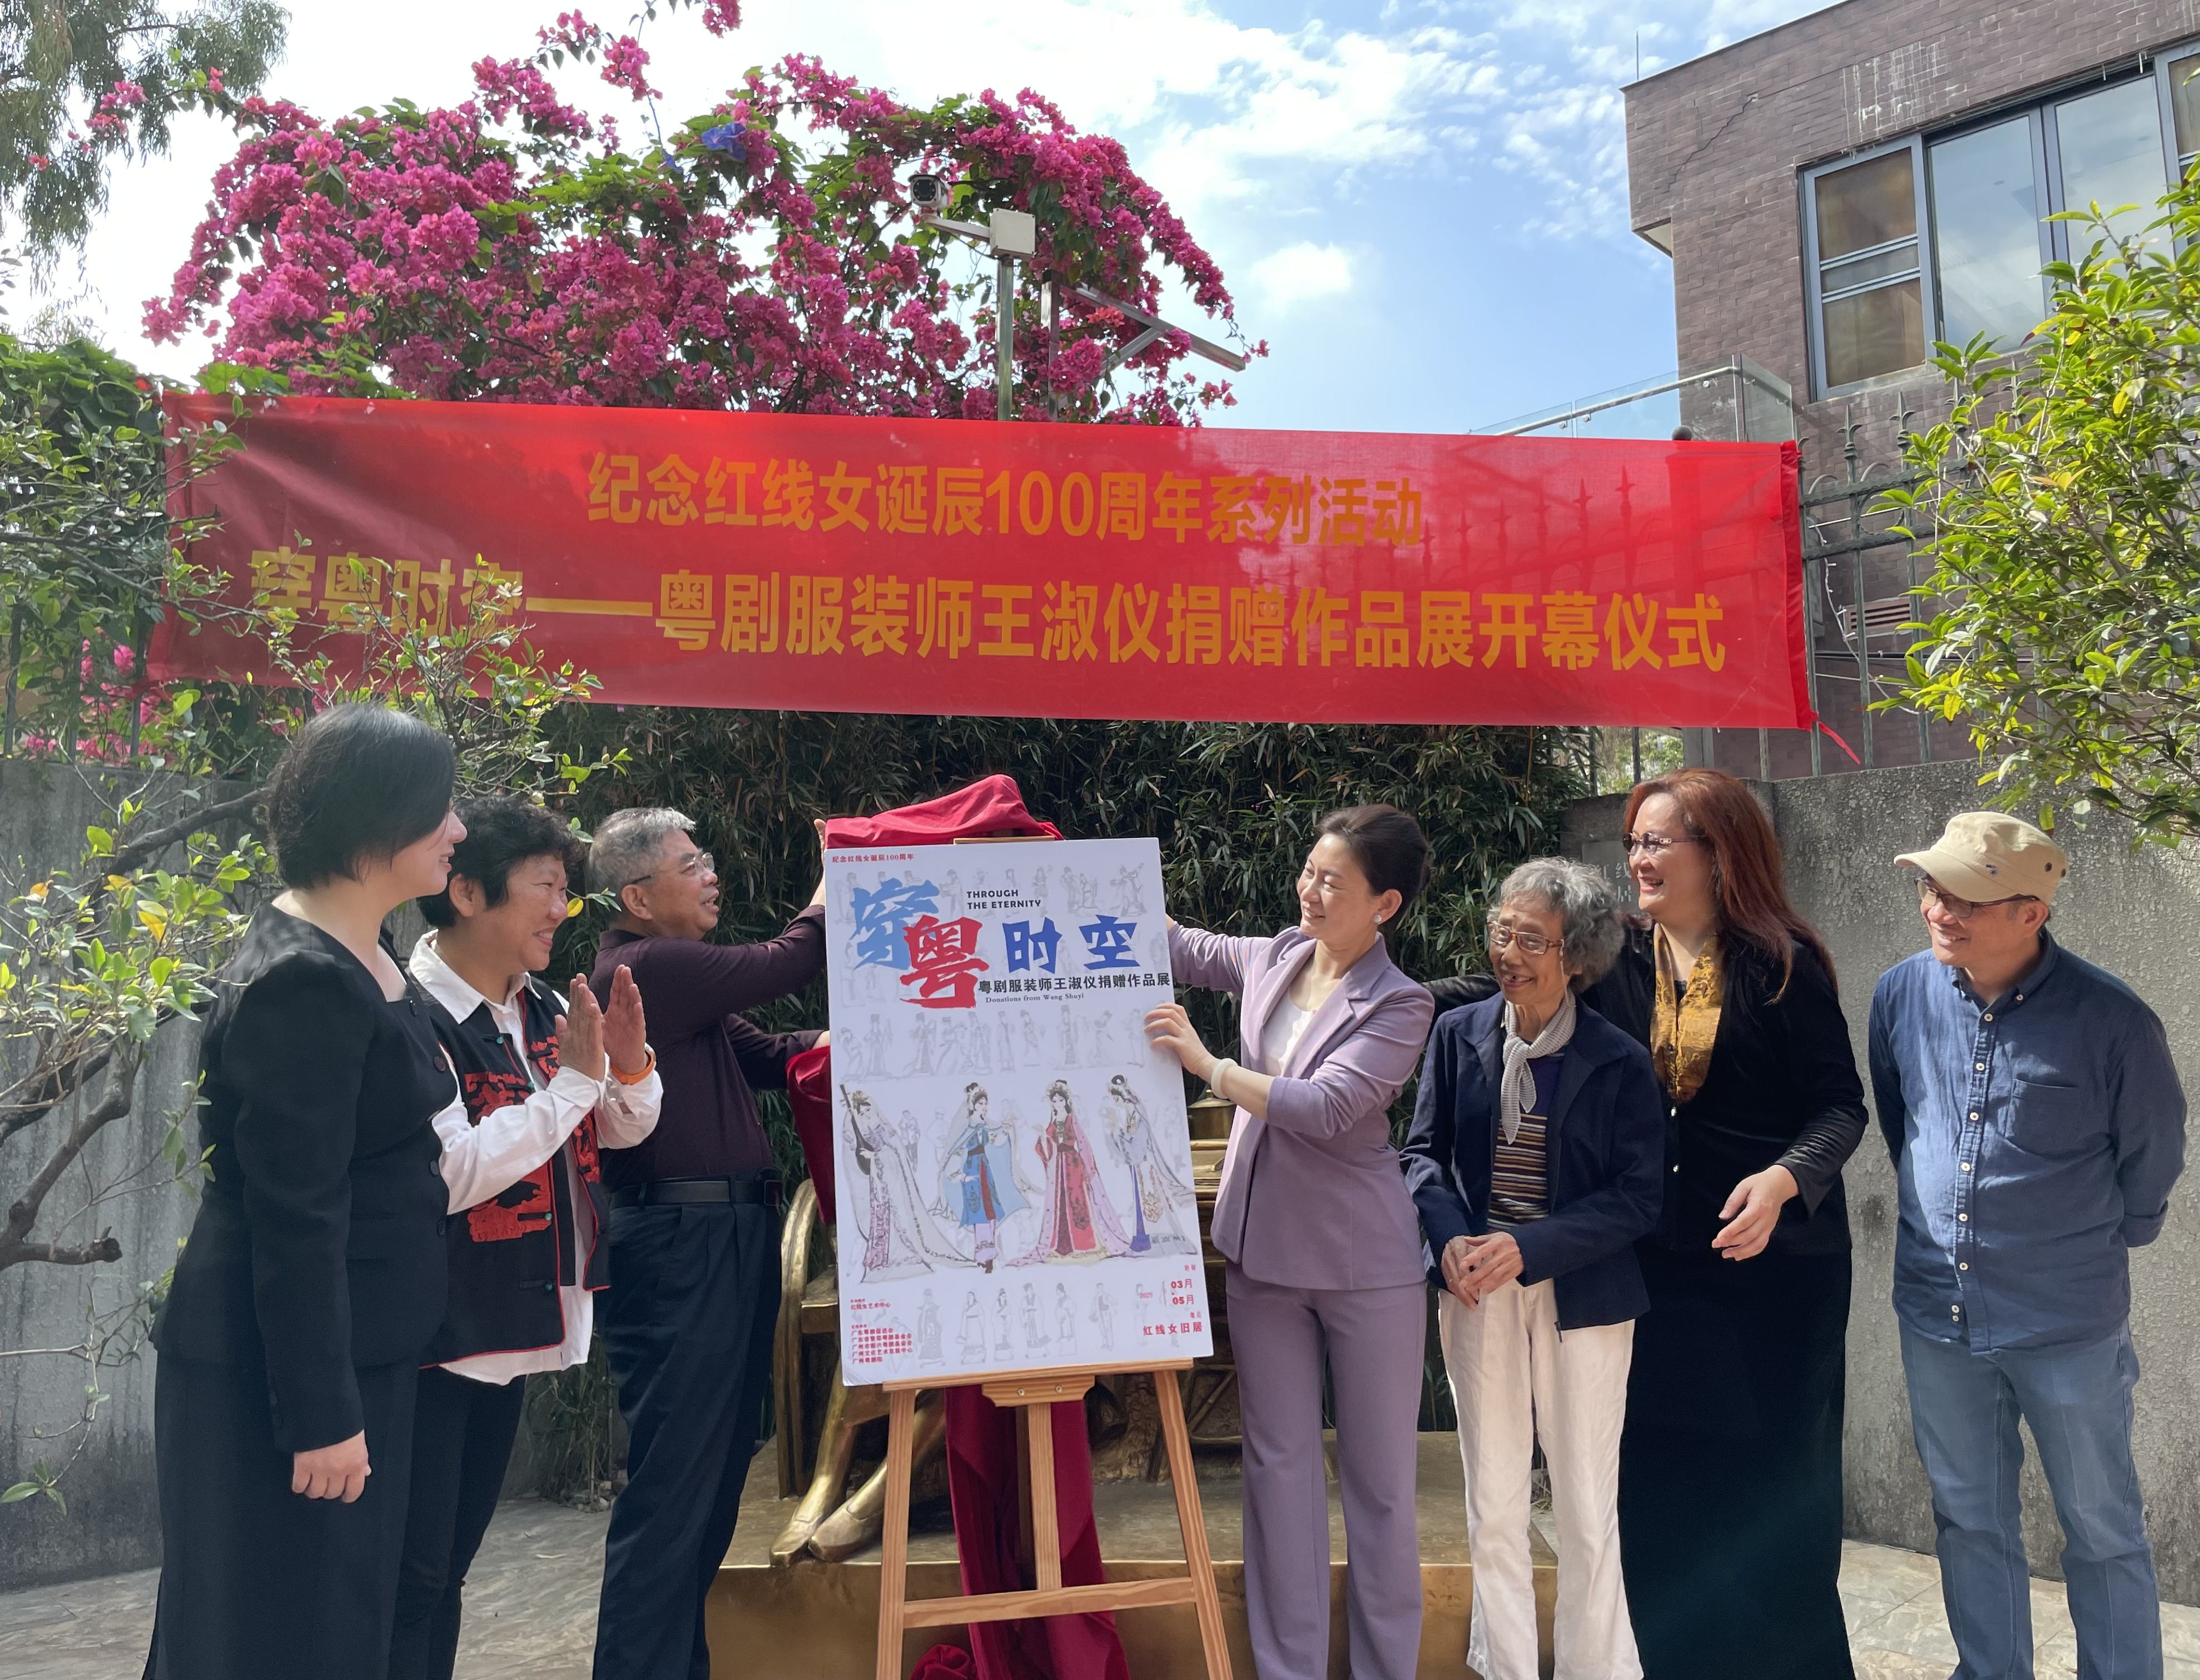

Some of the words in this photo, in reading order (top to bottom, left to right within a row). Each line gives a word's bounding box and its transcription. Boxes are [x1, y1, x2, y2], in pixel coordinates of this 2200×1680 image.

[588, 452, 1422, 546] 纪念红线女诞辰100周年系列活动
[832, 853, 914, 863] 纪念红线女诞辰100周年
[967, 889, 1018, 898] THROUGH
[991, 900, 1041, 908] ETERNITY
[979, 972, 1170, 993] 粤剧服装师王淑仪捐赠作品展
[1043, 994, 1062, 1002] Wang
[1065, 992, 1084, 1001] Shuyi
[1171, 1279, 1192, 1289] 03月
[1172, 1295, 1194, 1305] 05月
[1143, 1321, 1202, 1335] 红线女旧居
